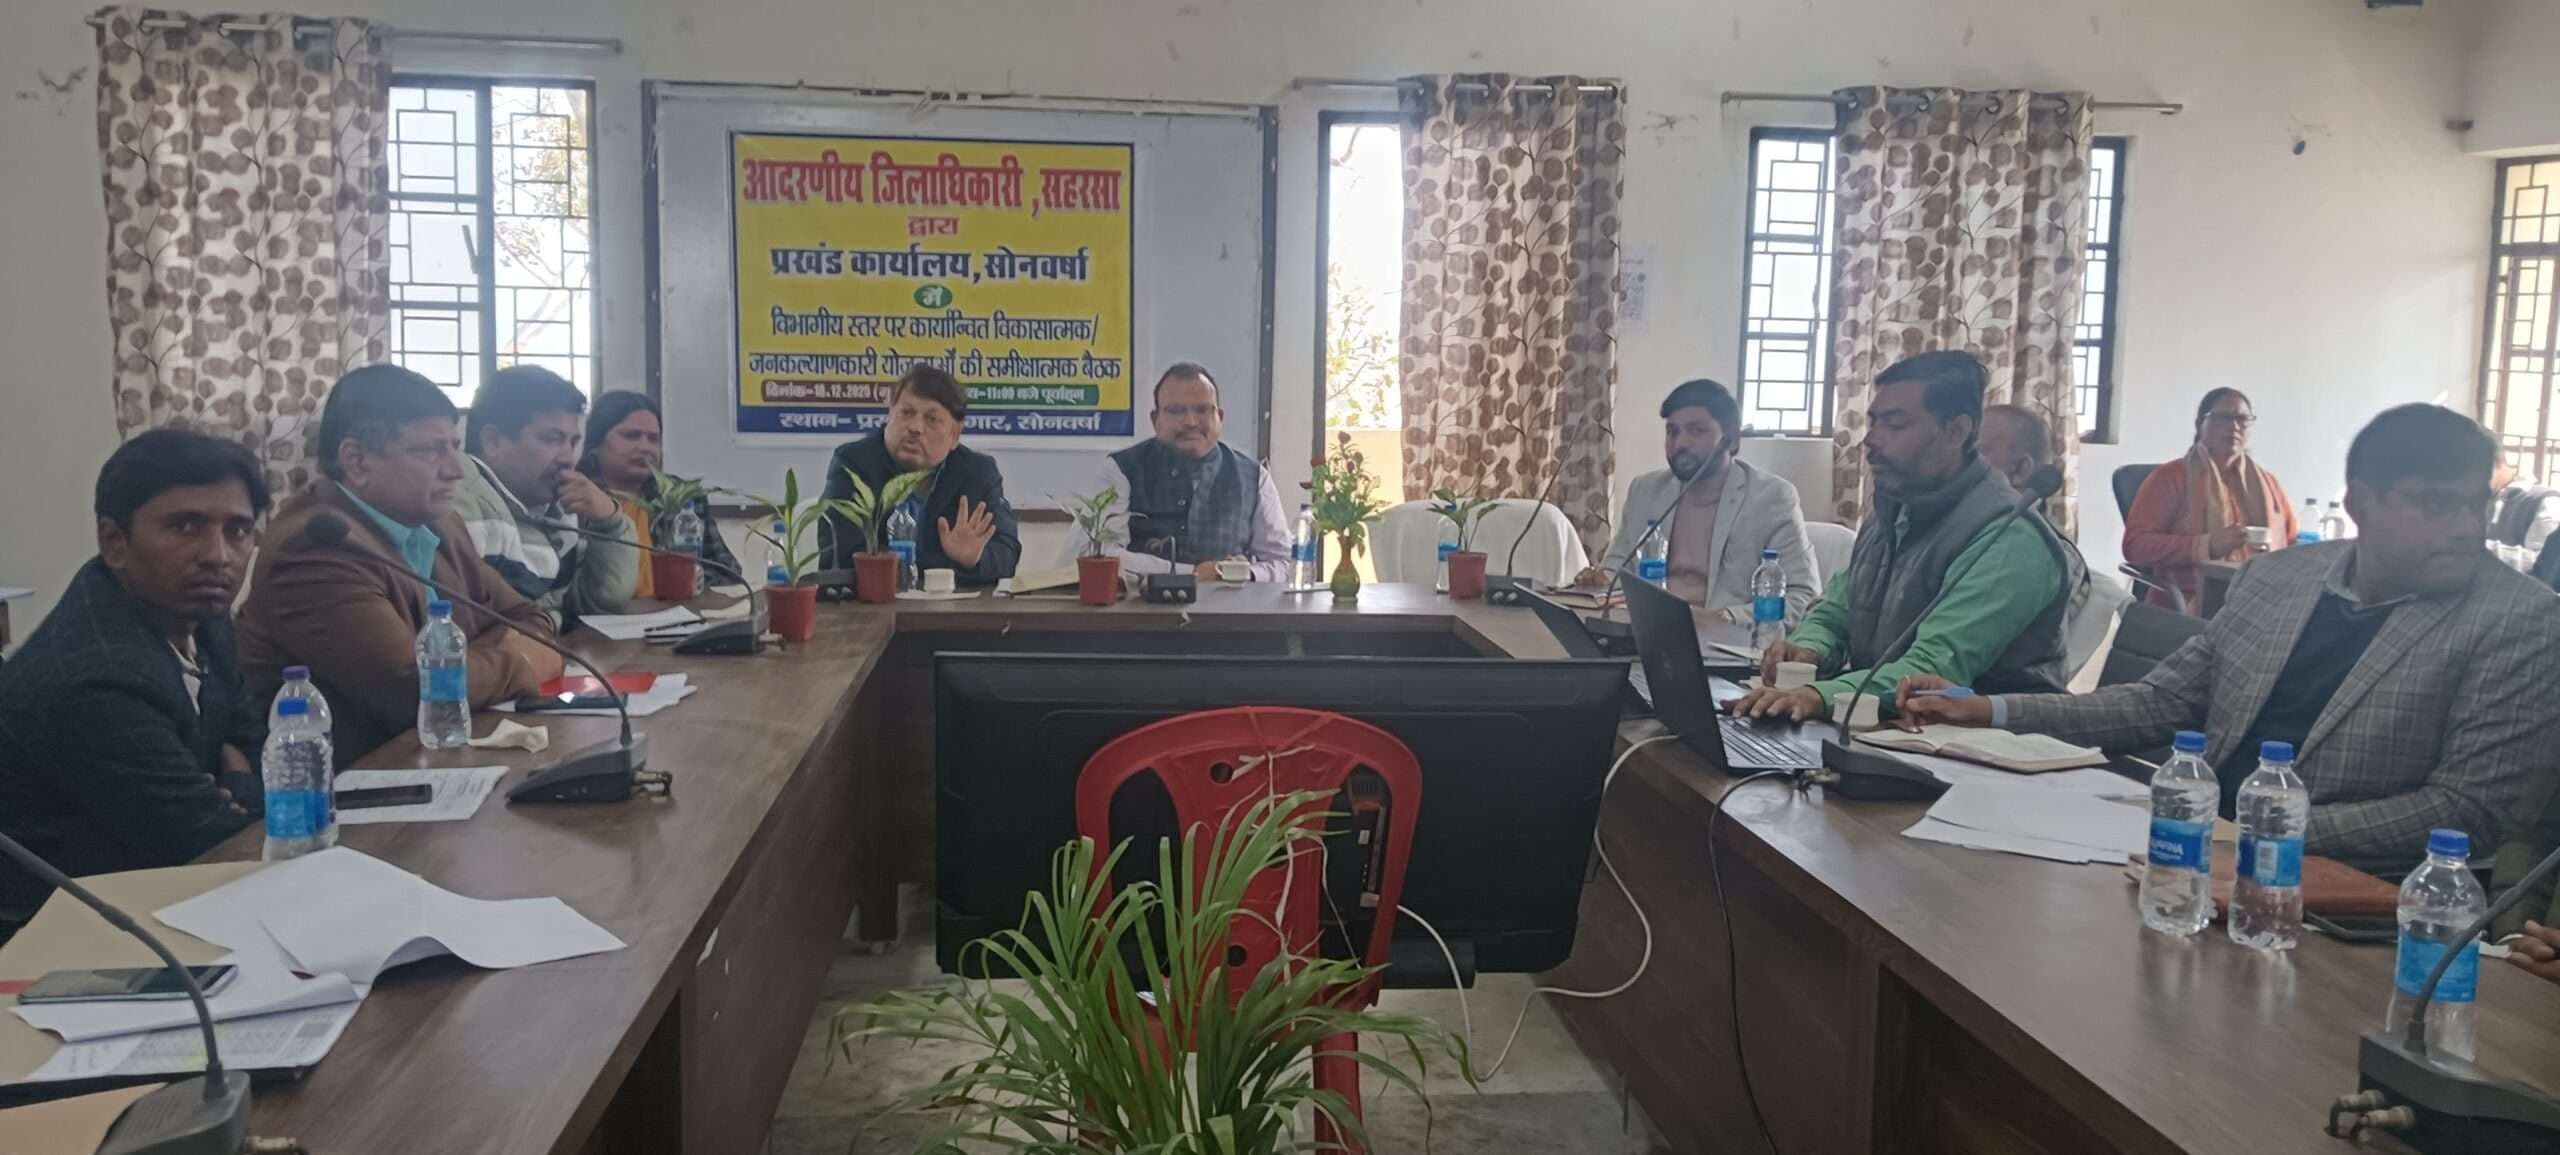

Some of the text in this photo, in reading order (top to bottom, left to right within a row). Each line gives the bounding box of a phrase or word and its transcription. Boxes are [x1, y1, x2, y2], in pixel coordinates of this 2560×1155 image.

[743, 149, 864, 203] आदरणीय
[871, 151, 1024, 208] जिलाधिकारी
[908, 216, 959, 237] द्वारा
[770, 242, 843, 275] प्रखंड
[771, 305, 843, 337] विभागीय
[848, 314, 880, 337] स्तर
[884, 315, 906, 338] पर
[749, 346, 877, 376] जनकल्याणकारी
[960, 348, 982, 377] की
[987, 349, 1080, 379] समीक्षात्मक
[1081, 350, 1122, 380] बैठक
[1017, 411, 1102, 432] सोनवर्षा
